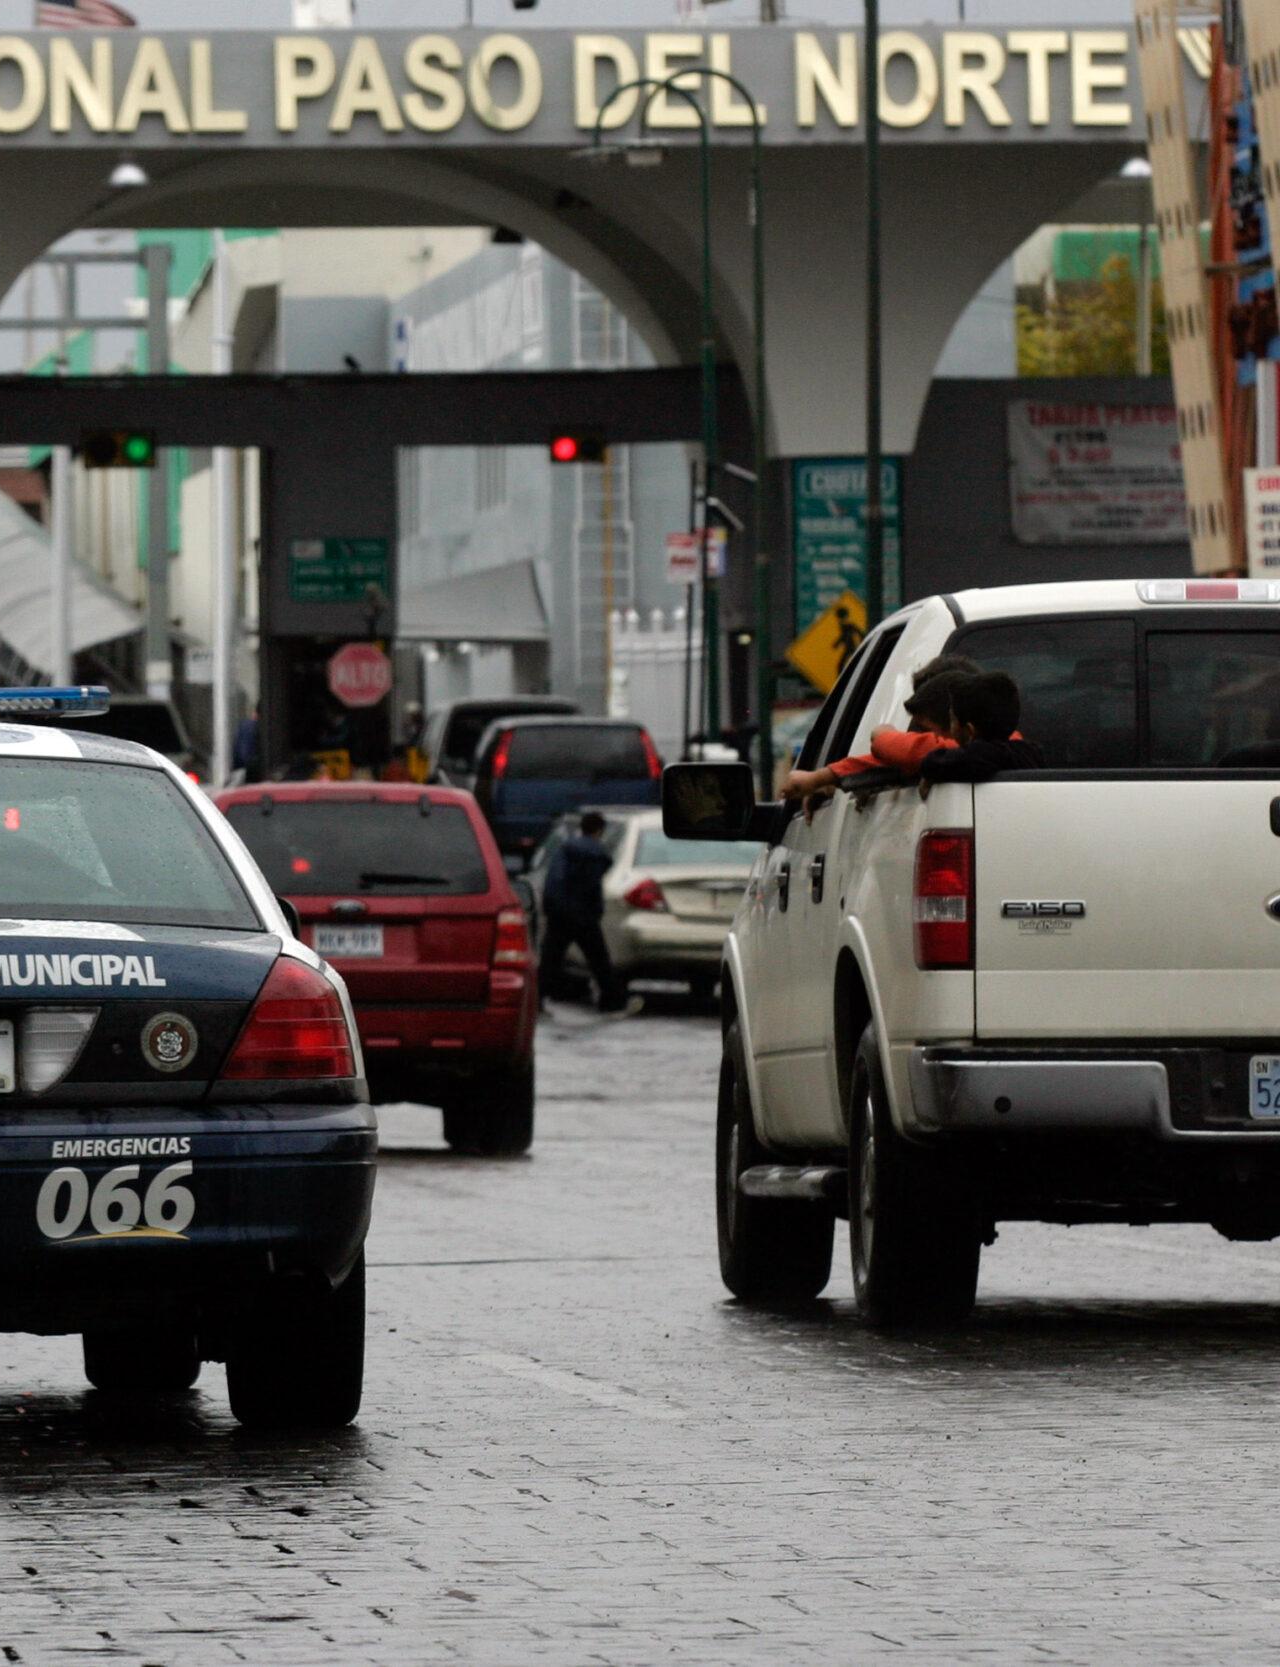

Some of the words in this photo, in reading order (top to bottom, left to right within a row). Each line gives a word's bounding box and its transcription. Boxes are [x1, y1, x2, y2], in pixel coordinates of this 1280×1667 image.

[275, 34, 543, 132] PASO
[574, 34, 768, 129] DEL
[795, 31, 1132, 127] NORTE
[1001, 901, 1086, 918] F-150
[1255, 1061, 1269, 1074] SN
[51, 1136, 192, 1159] EMERGENCIAS
[36, 1159, 196, 1240] 066
